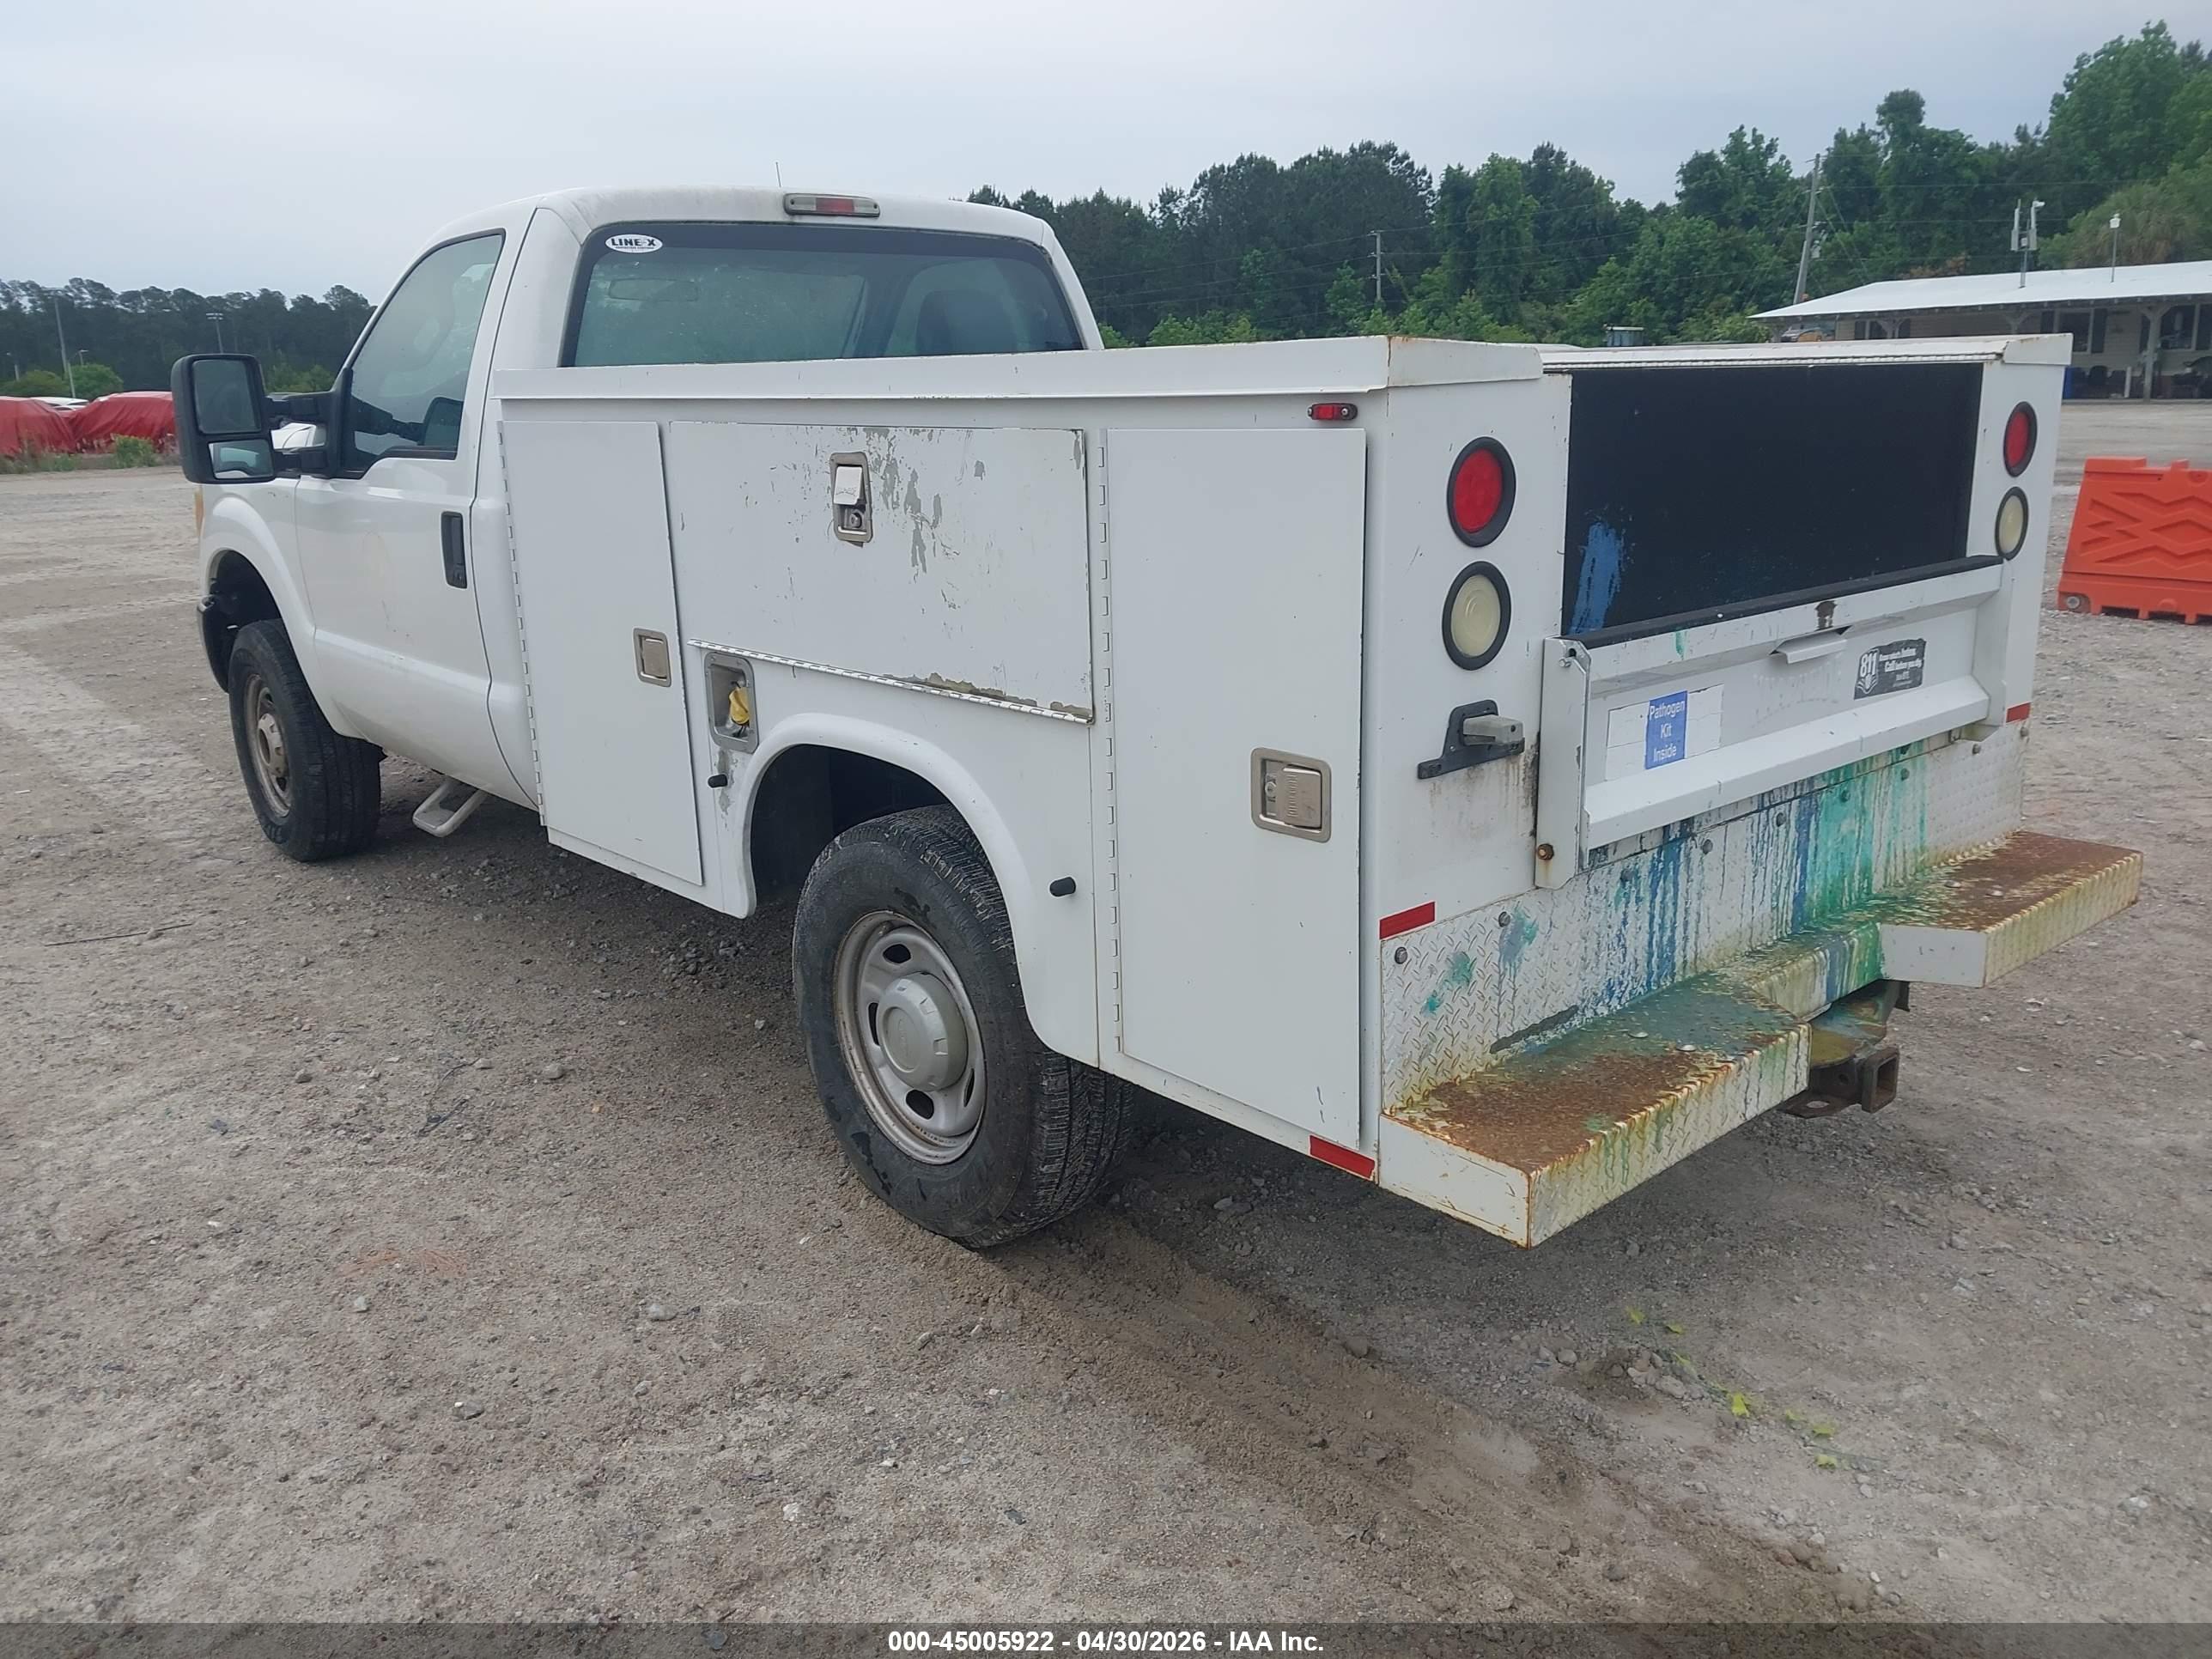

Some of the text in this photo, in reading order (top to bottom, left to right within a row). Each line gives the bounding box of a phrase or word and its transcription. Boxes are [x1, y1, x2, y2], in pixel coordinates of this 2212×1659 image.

[1860, 653, 1877, 678] 811
[1649, 700, 1685, 720] Pathogen
[1660, 723, 1672, 738] Kit
[1653, 743, 1677, 763] Inside
